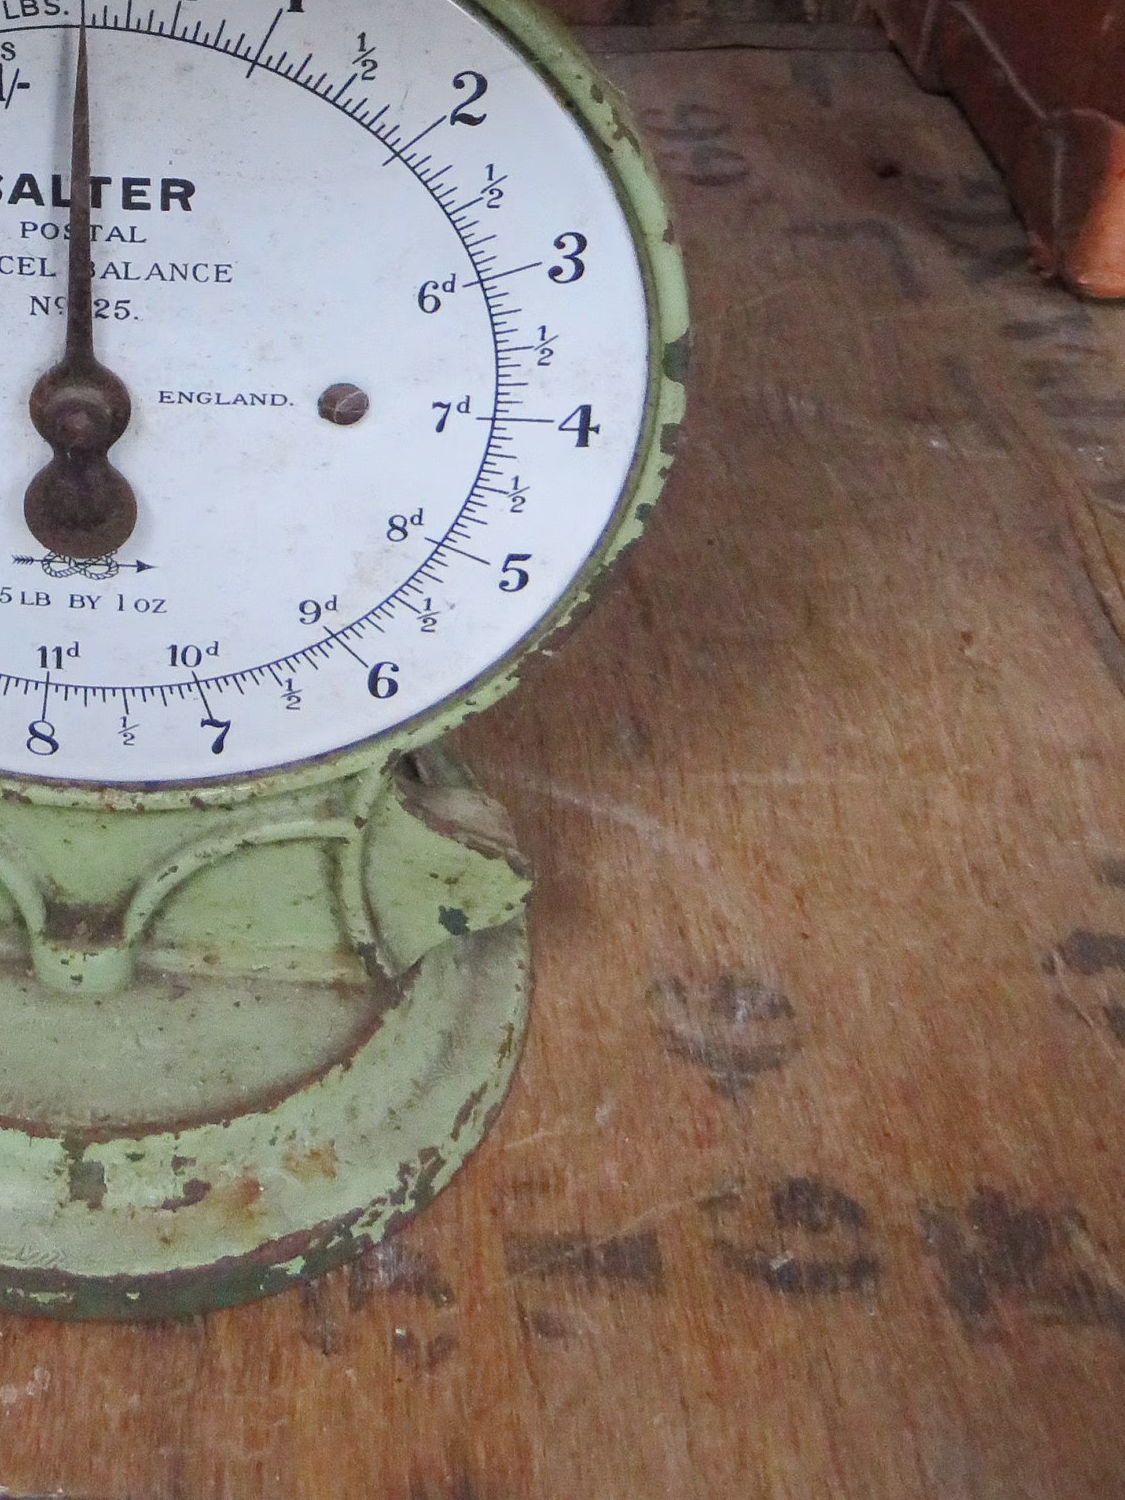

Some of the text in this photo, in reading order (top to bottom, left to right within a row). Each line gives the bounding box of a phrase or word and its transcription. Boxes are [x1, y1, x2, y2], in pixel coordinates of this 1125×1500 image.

[450, 70, 489, 126] 2
[547, 231, 588, 283] 3
[158, 390, 295, 408] ENGLAND.
[558, 404, 600, 448] 4
[498, 554, 533, 593] 5
[68, 593, 102, 610] BY
[367, 661, 400, 700] 6
[26, 720, 60, 756] 8
[200, 718, 231, 755] 7
